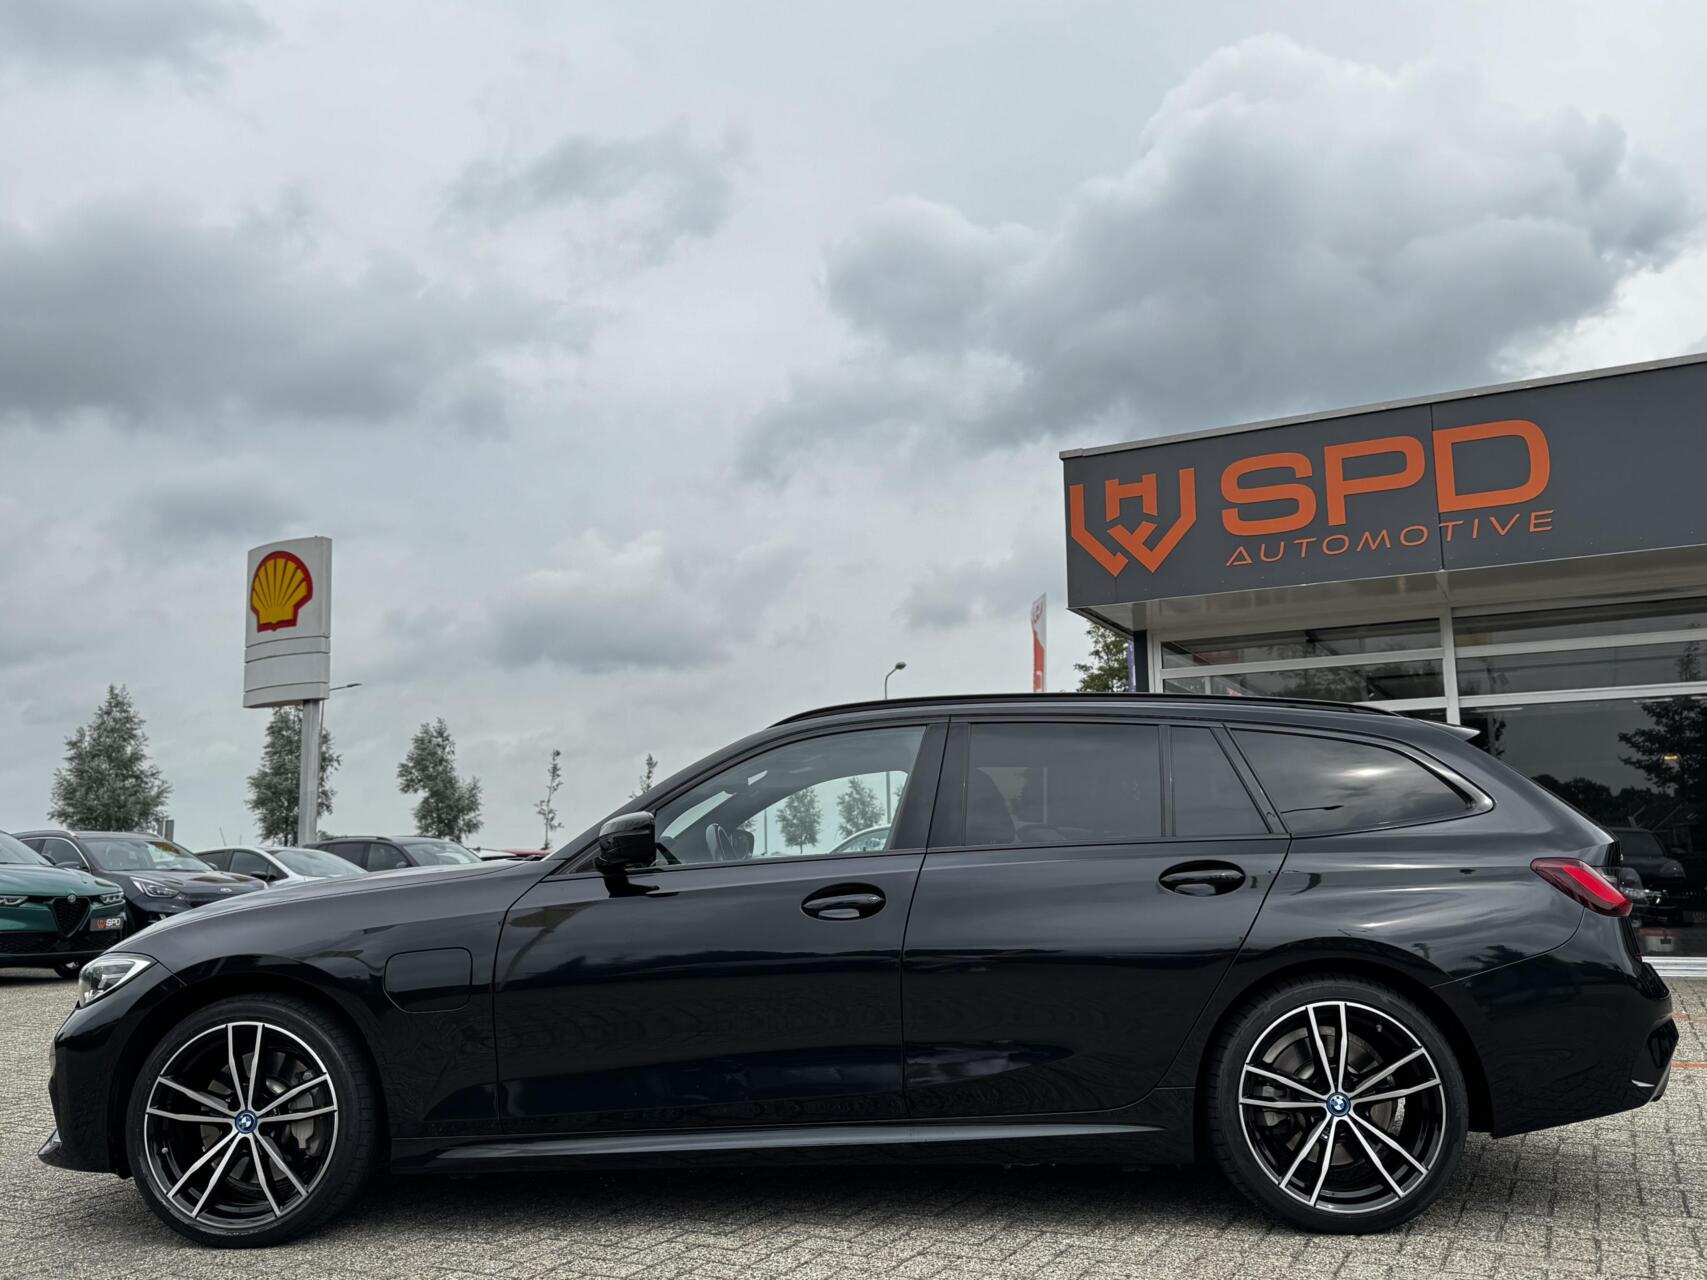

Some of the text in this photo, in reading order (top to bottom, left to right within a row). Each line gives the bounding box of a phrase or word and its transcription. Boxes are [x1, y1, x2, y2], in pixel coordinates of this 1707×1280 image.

[1220, 419, 1551, 538] SPD
[1227, 511, 1553, 566] AUTOMOTIVE
[106, 918, 121, 926] SPD
